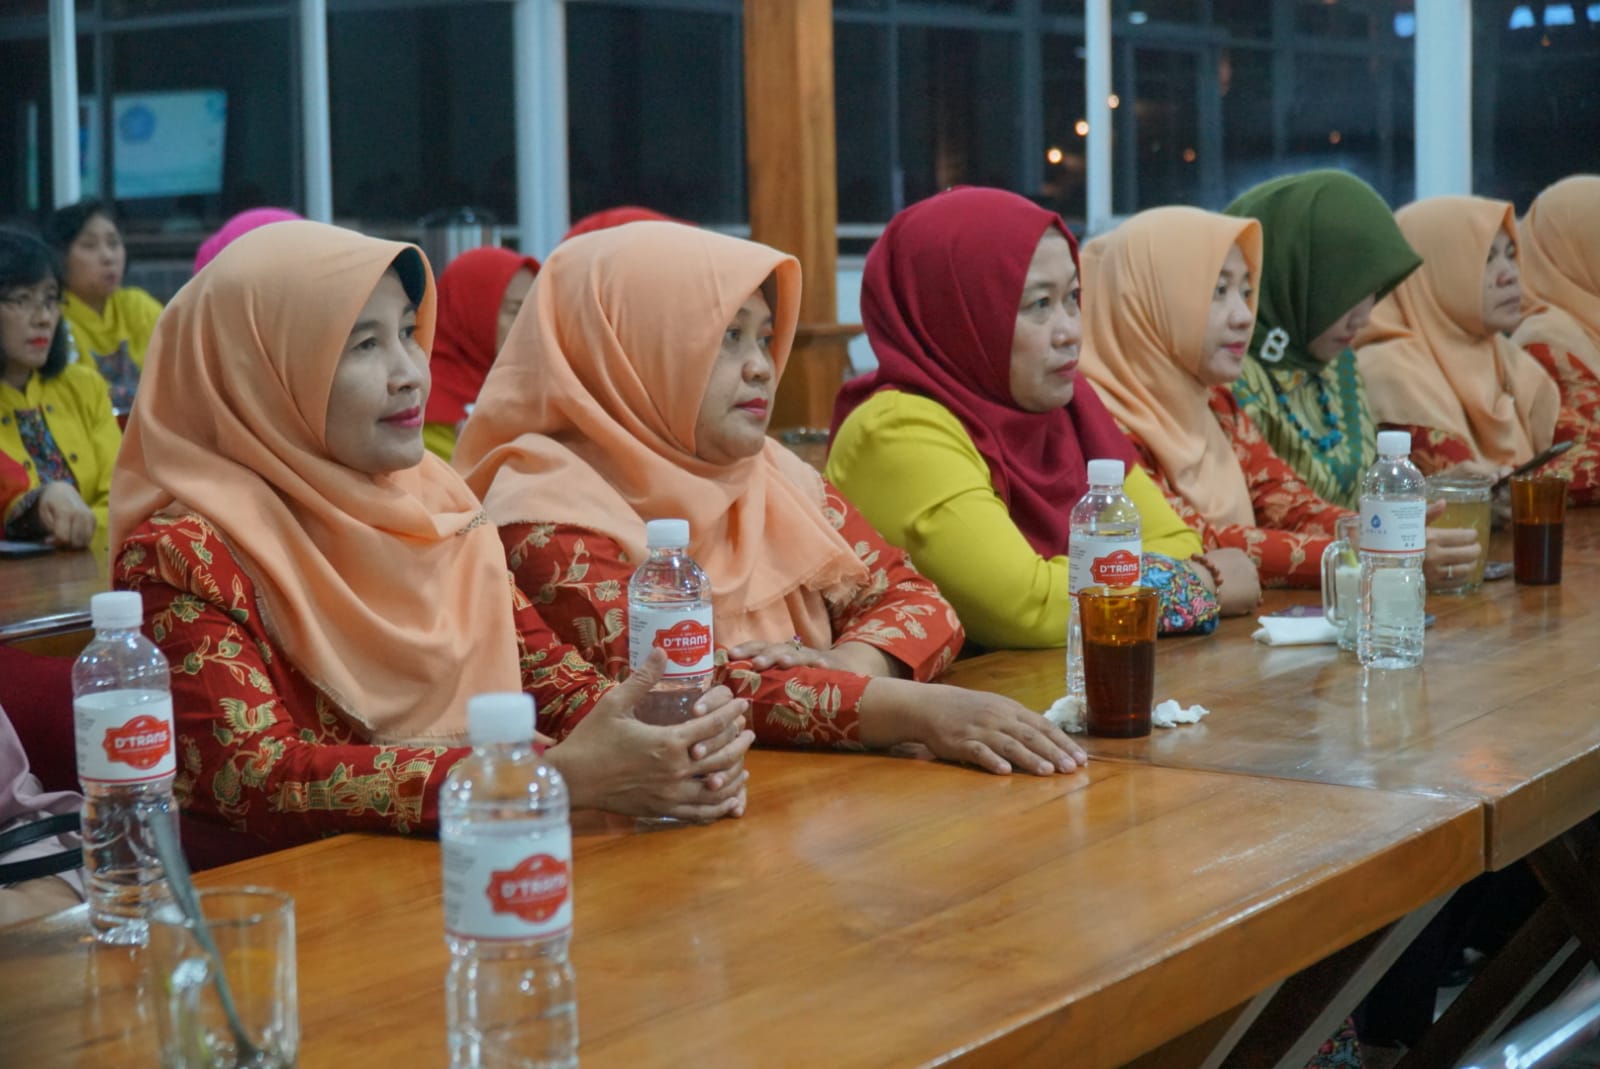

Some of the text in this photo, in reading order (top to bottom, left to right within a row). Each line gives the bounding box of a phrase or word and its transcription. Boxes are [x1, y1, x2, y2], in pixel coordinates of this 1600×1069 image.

[1100, 563, 1137, 573] D'TRANS
[663, 635, 707, 647] D'TRANS
[115, 731, 167, 748] D'TRANS
